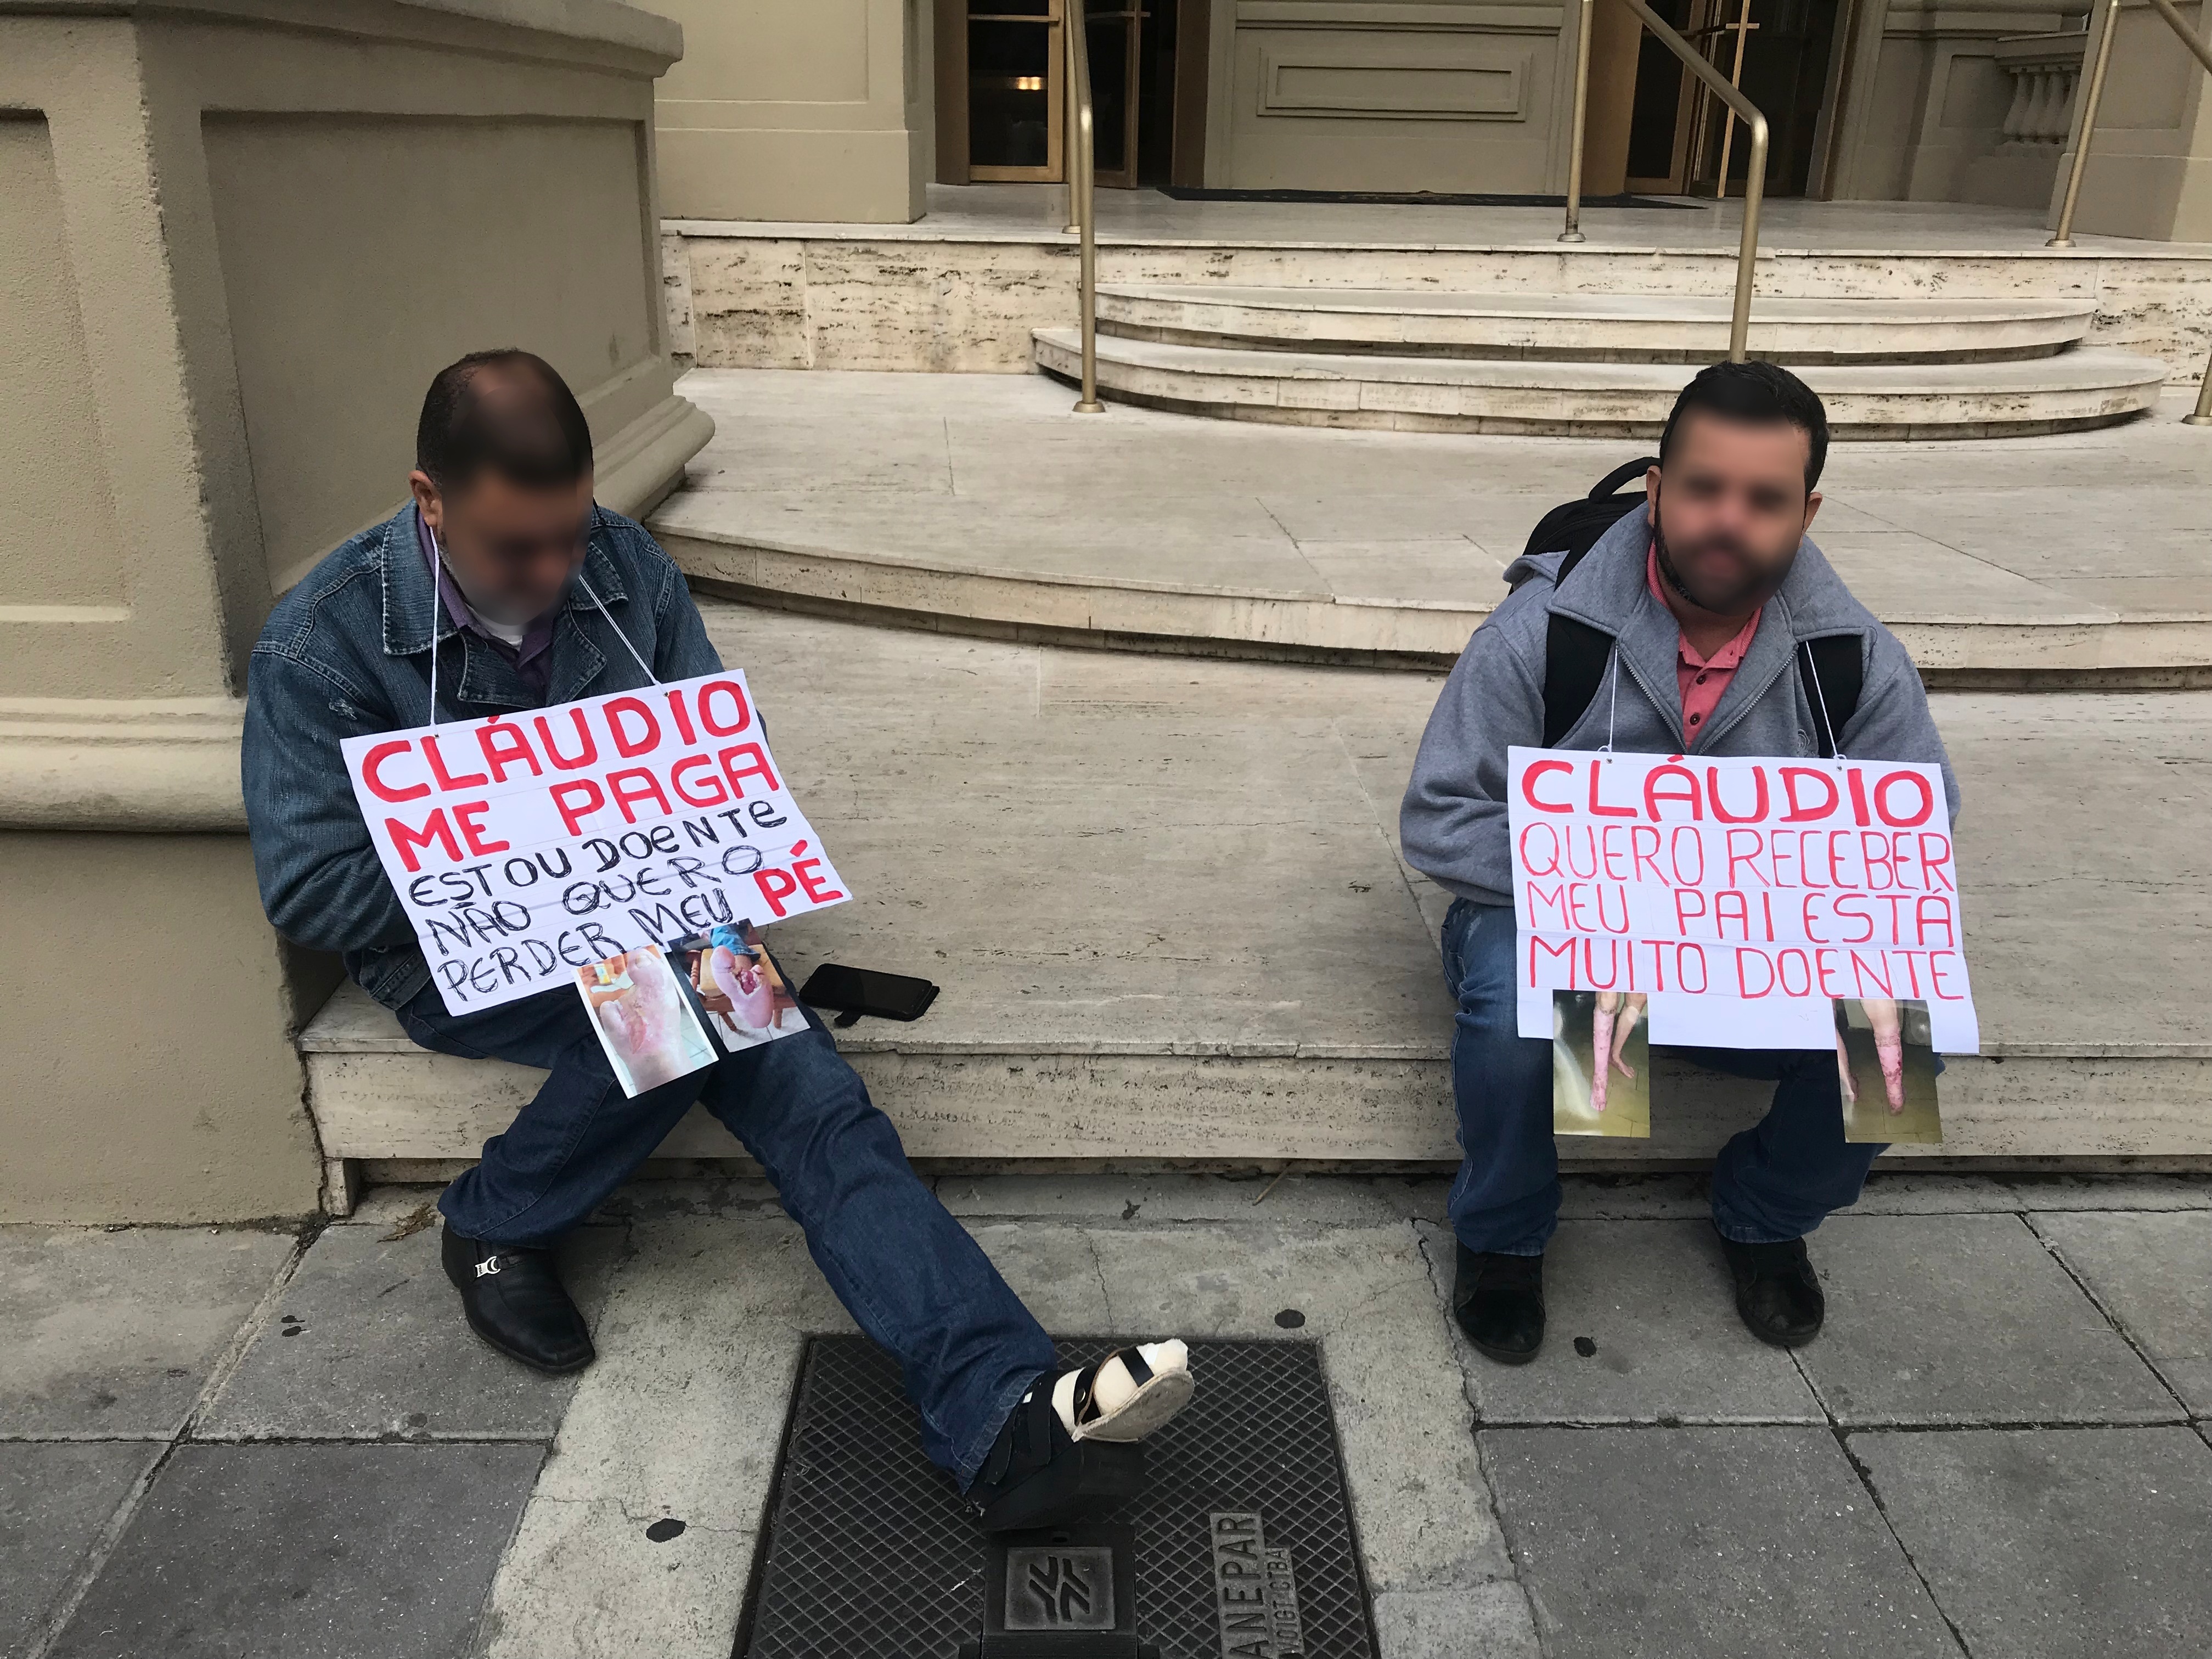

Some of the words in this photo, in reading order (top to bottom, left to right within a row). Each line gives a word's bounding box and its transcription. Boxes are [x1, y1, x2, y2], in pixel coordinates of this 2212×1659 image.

[362, 680, 751, 803] CLÁUDIO
[385, 800, 510, 872] ME
[549, 743, 779, 836] PAGA
[1522, 755, 1933, 827] CLÁUDIO
[409, 848, 572, 907] ESTOU
[1519, 822, 1704, 888] QUERO
[1726, 829, 1954, 892] RECEBER
[426, 900, 531, 955] NÃO
[562, 845, 764, 915] QUERO
[437, 923, 623, 1002] PERDER
[629, 888, 734, 951] MEU
[755, 839, 843, 918] PÉ
[1527, 881, 1631, 933] MEU
[1674, 888, 1774, 942] PAI
[1802, 887, 1954, 947] ESTÁ
[1530, 936, 1707, 994] MUITO
[1736, 947, 1964, 1000] DOENTE
